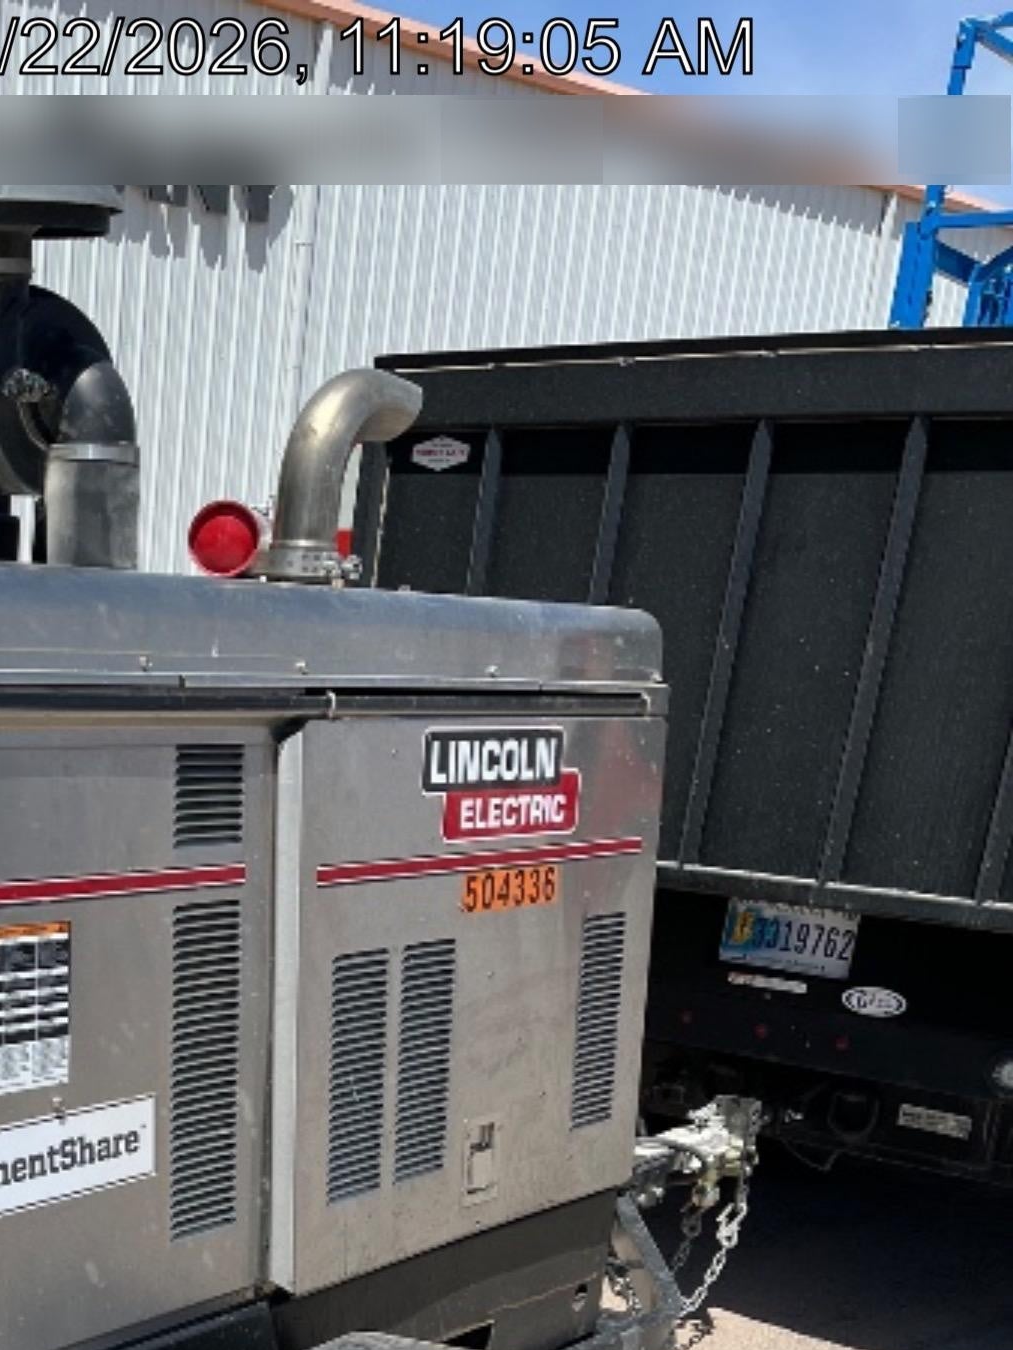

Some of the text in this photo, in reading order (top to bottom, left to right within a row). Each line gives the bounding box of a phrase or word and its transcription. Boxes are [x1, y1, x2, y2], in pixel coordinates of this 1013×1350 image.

[430, 737, 558, 784] LINCOLN
[459, 794, 567, 830] ELECTRIC
[462, 866, 556, 913] 504336
